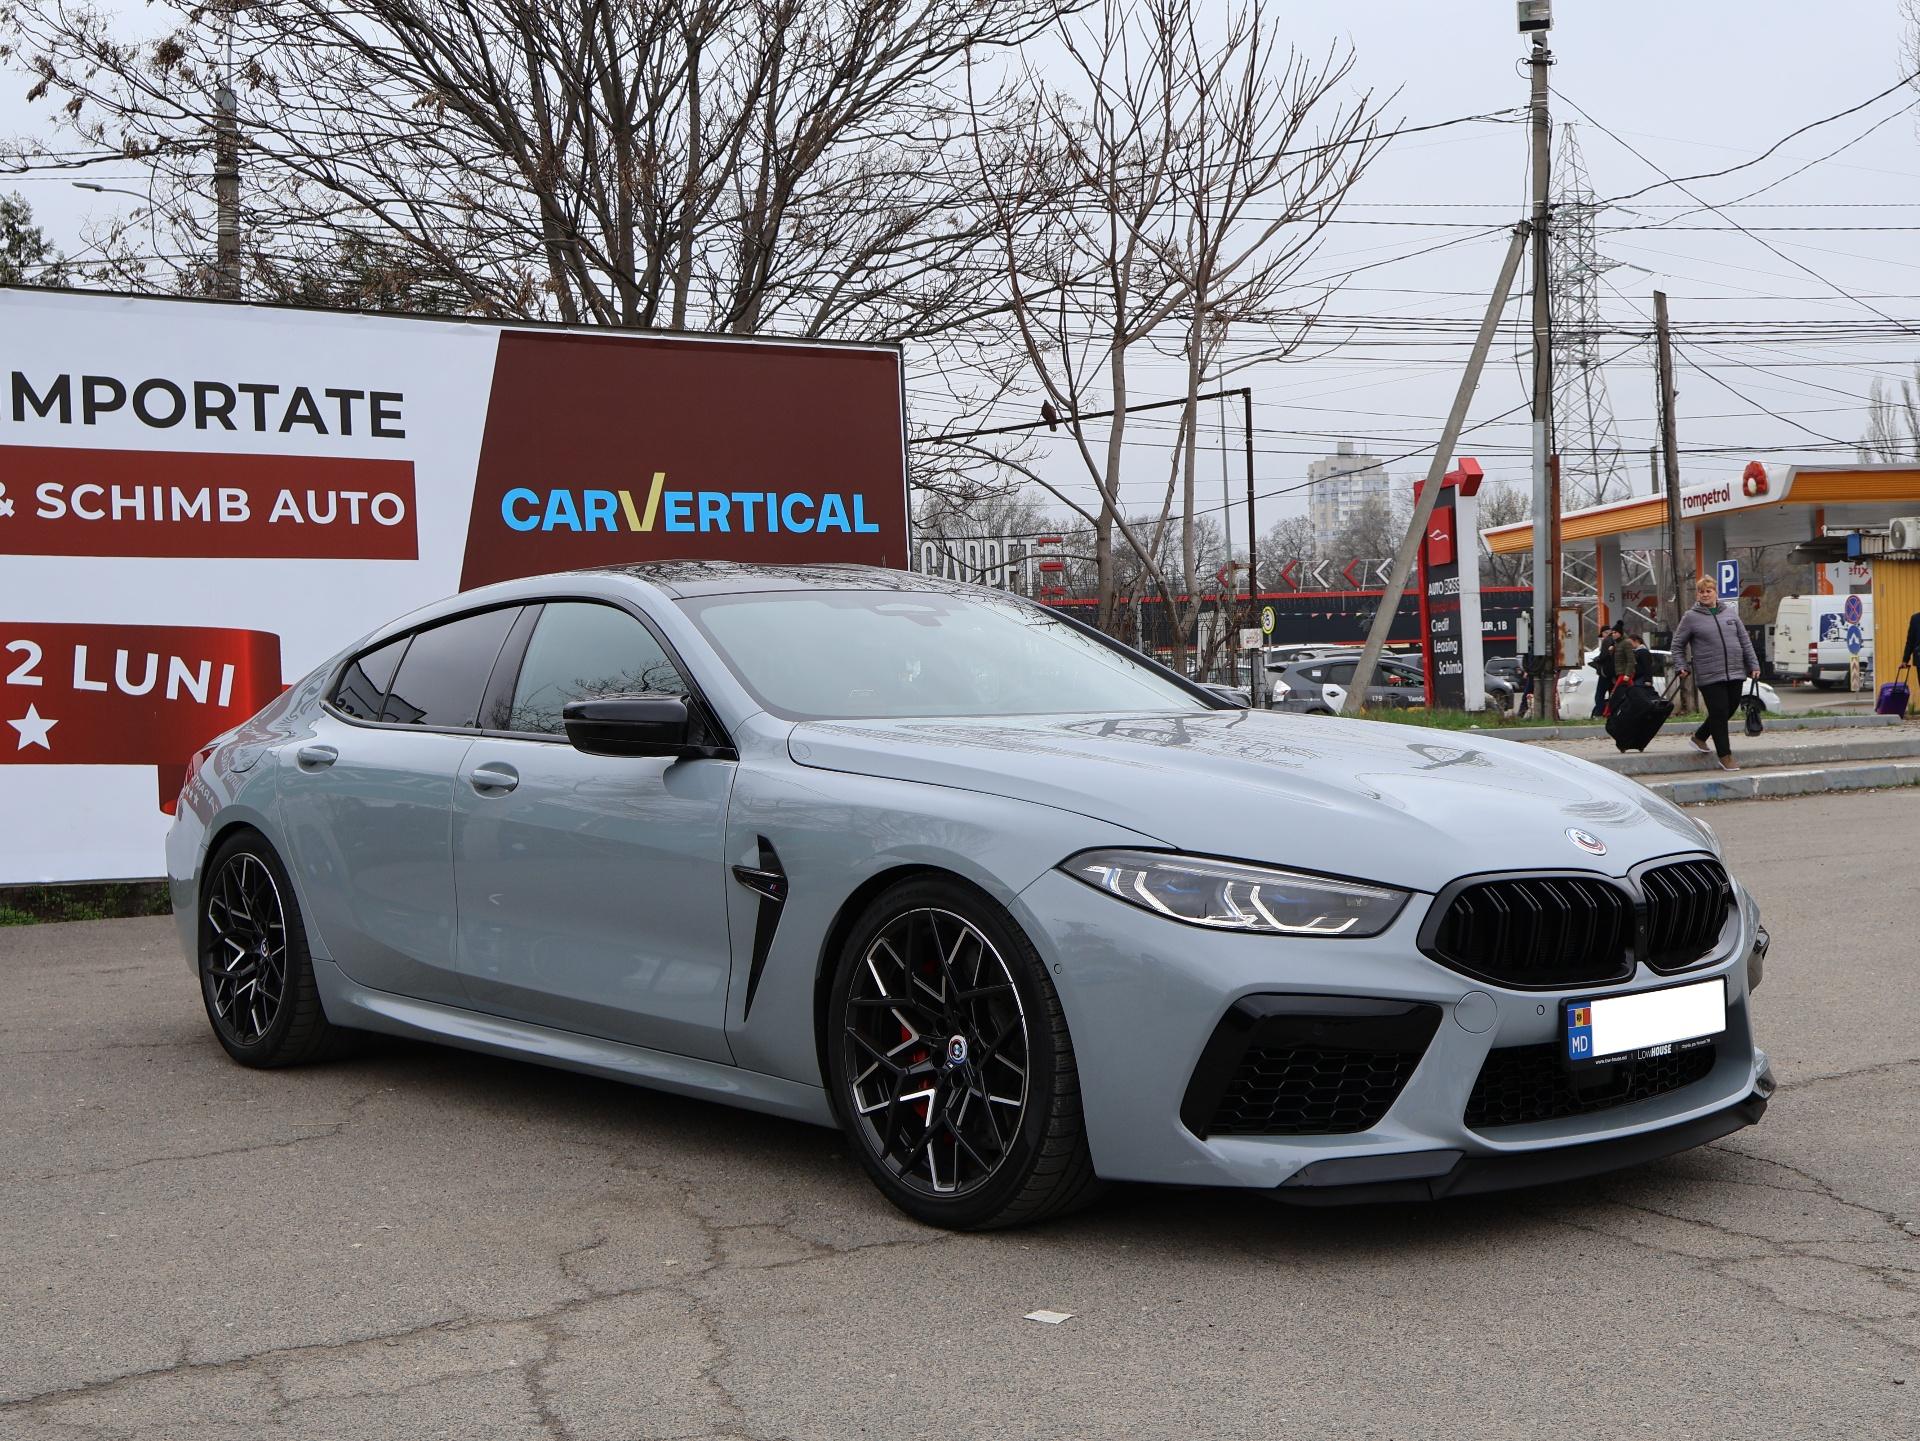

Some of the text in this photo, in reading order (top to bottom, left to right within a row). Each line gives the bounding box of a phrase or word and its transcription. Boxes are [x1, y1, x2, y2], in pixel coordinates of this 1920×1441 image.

[36, 482, 251, 523] SCHIMB
[268, 489, 405, 526] AUTO
[501, 472, 880, 533] CARVERTICAL
[1682, 482, 1731, 511] rompetrol
[1428, 578, 1460, 596] AUTO BOSS
[1721, 565, 1735, 594] P
[1609, 592, 1615, 602] 5
[1431, 617, 1449, 632] Credit
[1434, 638, 1458, 654] Leasing
[6, 639, 235, 708] 2 LUNI
[1438, 660, 1462, 675] Schimb
[1572, 1035, 1588, 1053] MD
[1637, 1044, 1672, 1060] LowHOUSE
